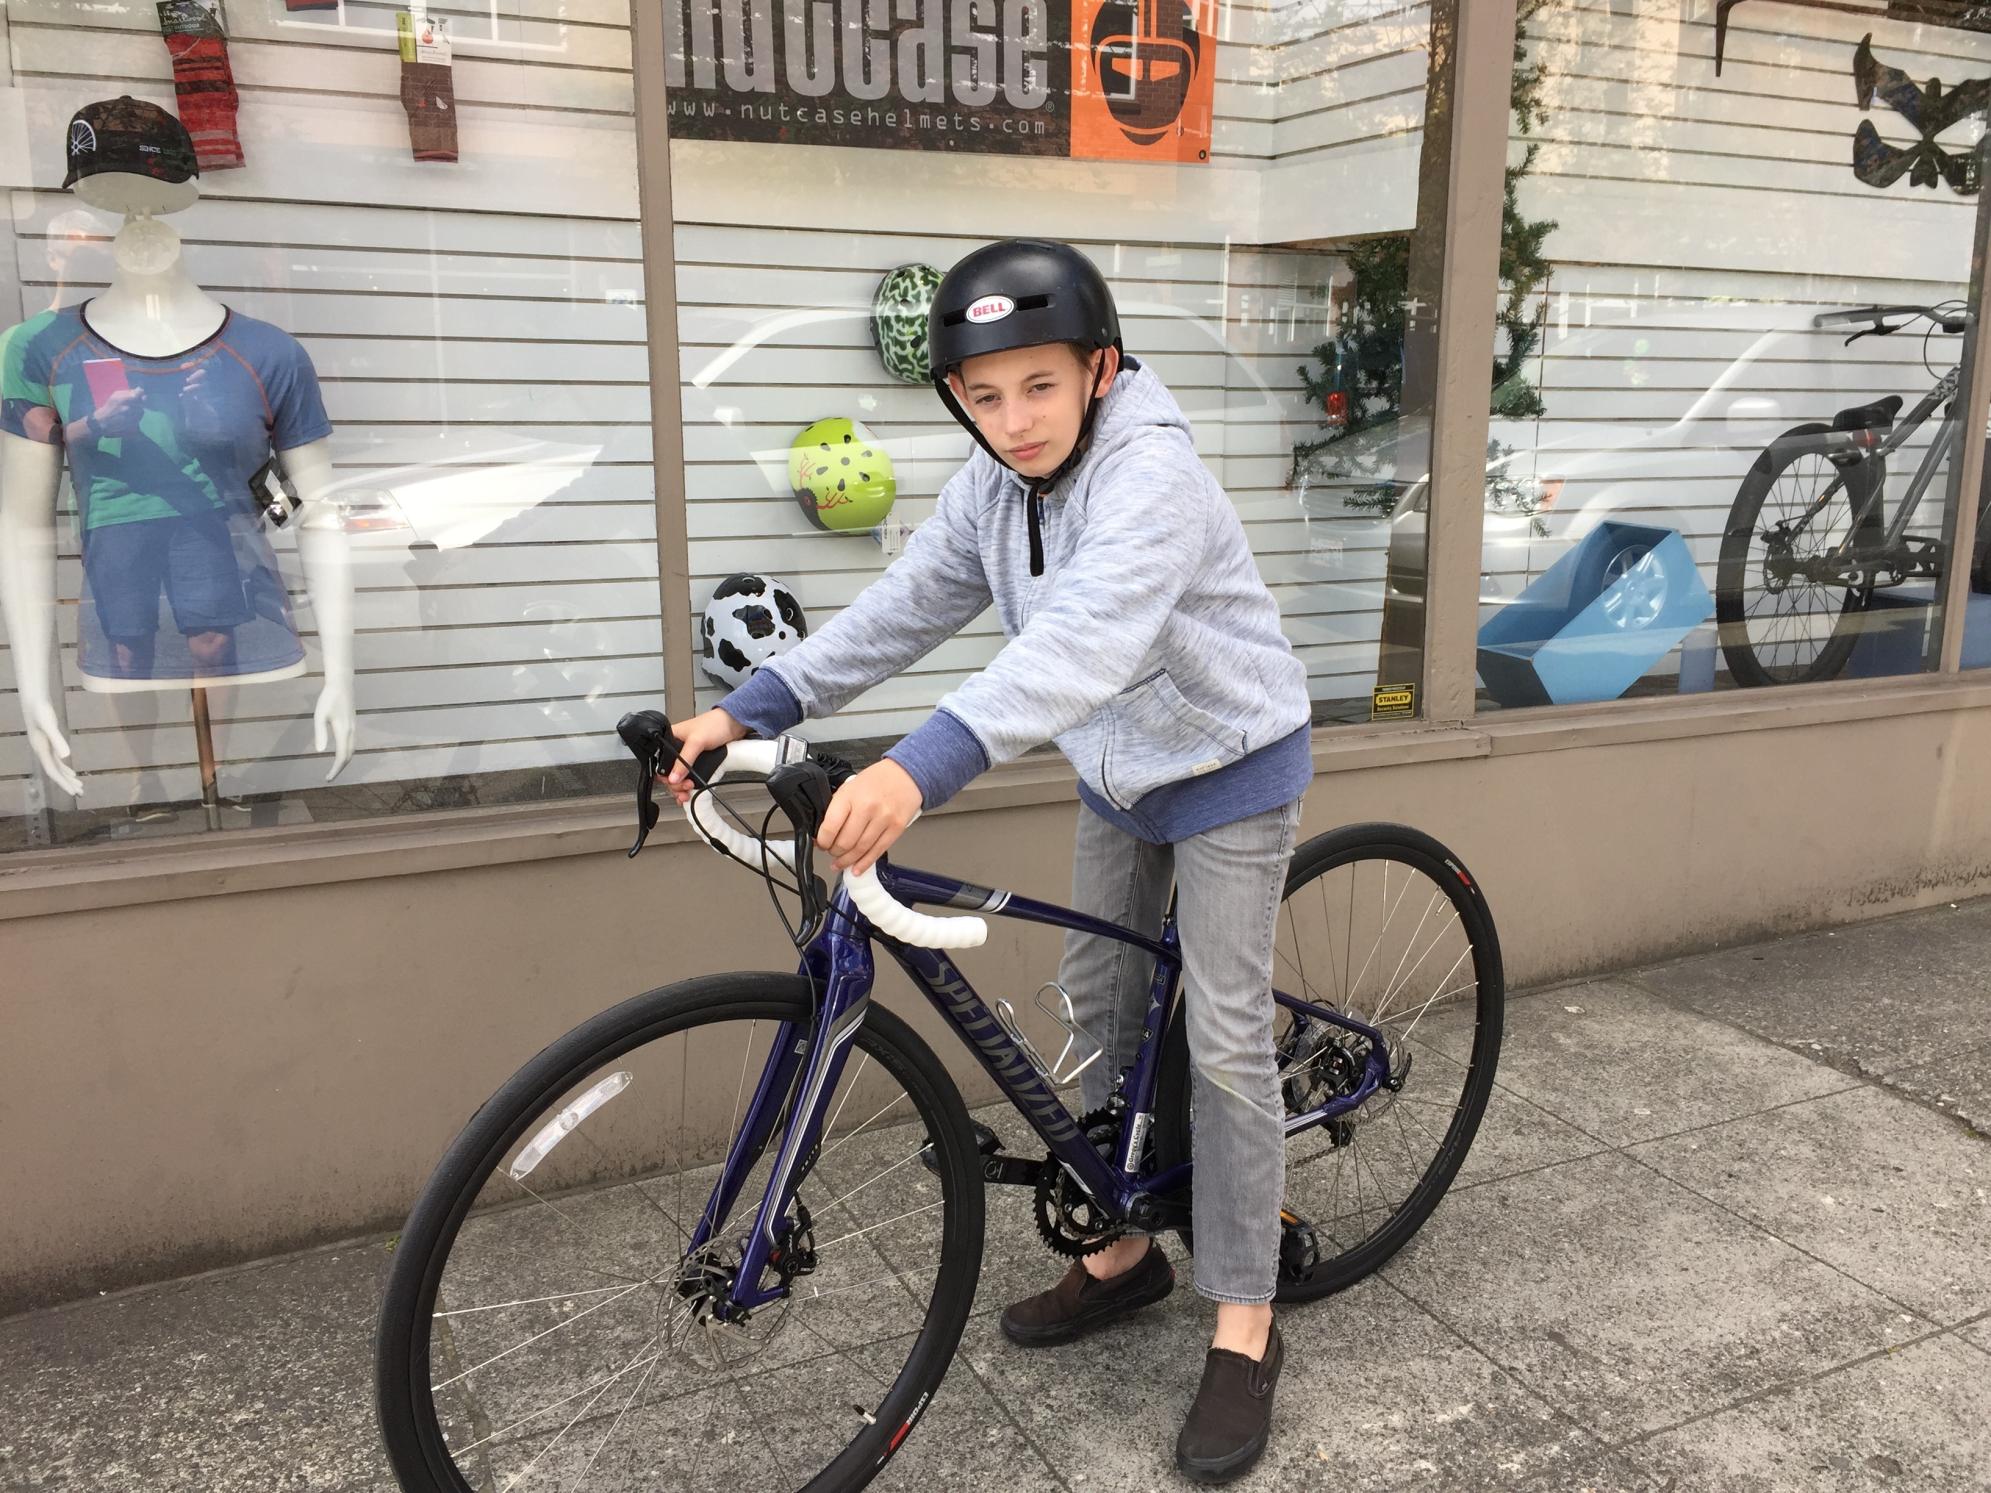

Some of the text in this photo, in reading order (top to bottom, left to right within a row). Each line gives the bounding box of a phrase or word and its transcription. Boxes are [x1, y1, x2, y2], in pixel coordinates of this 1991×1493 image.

[972, 301, 1006, 317] BELL
[1378, 694, 1409, 704] STANLEY
[924, 960, 1079, 1141] SPECIALIZED
